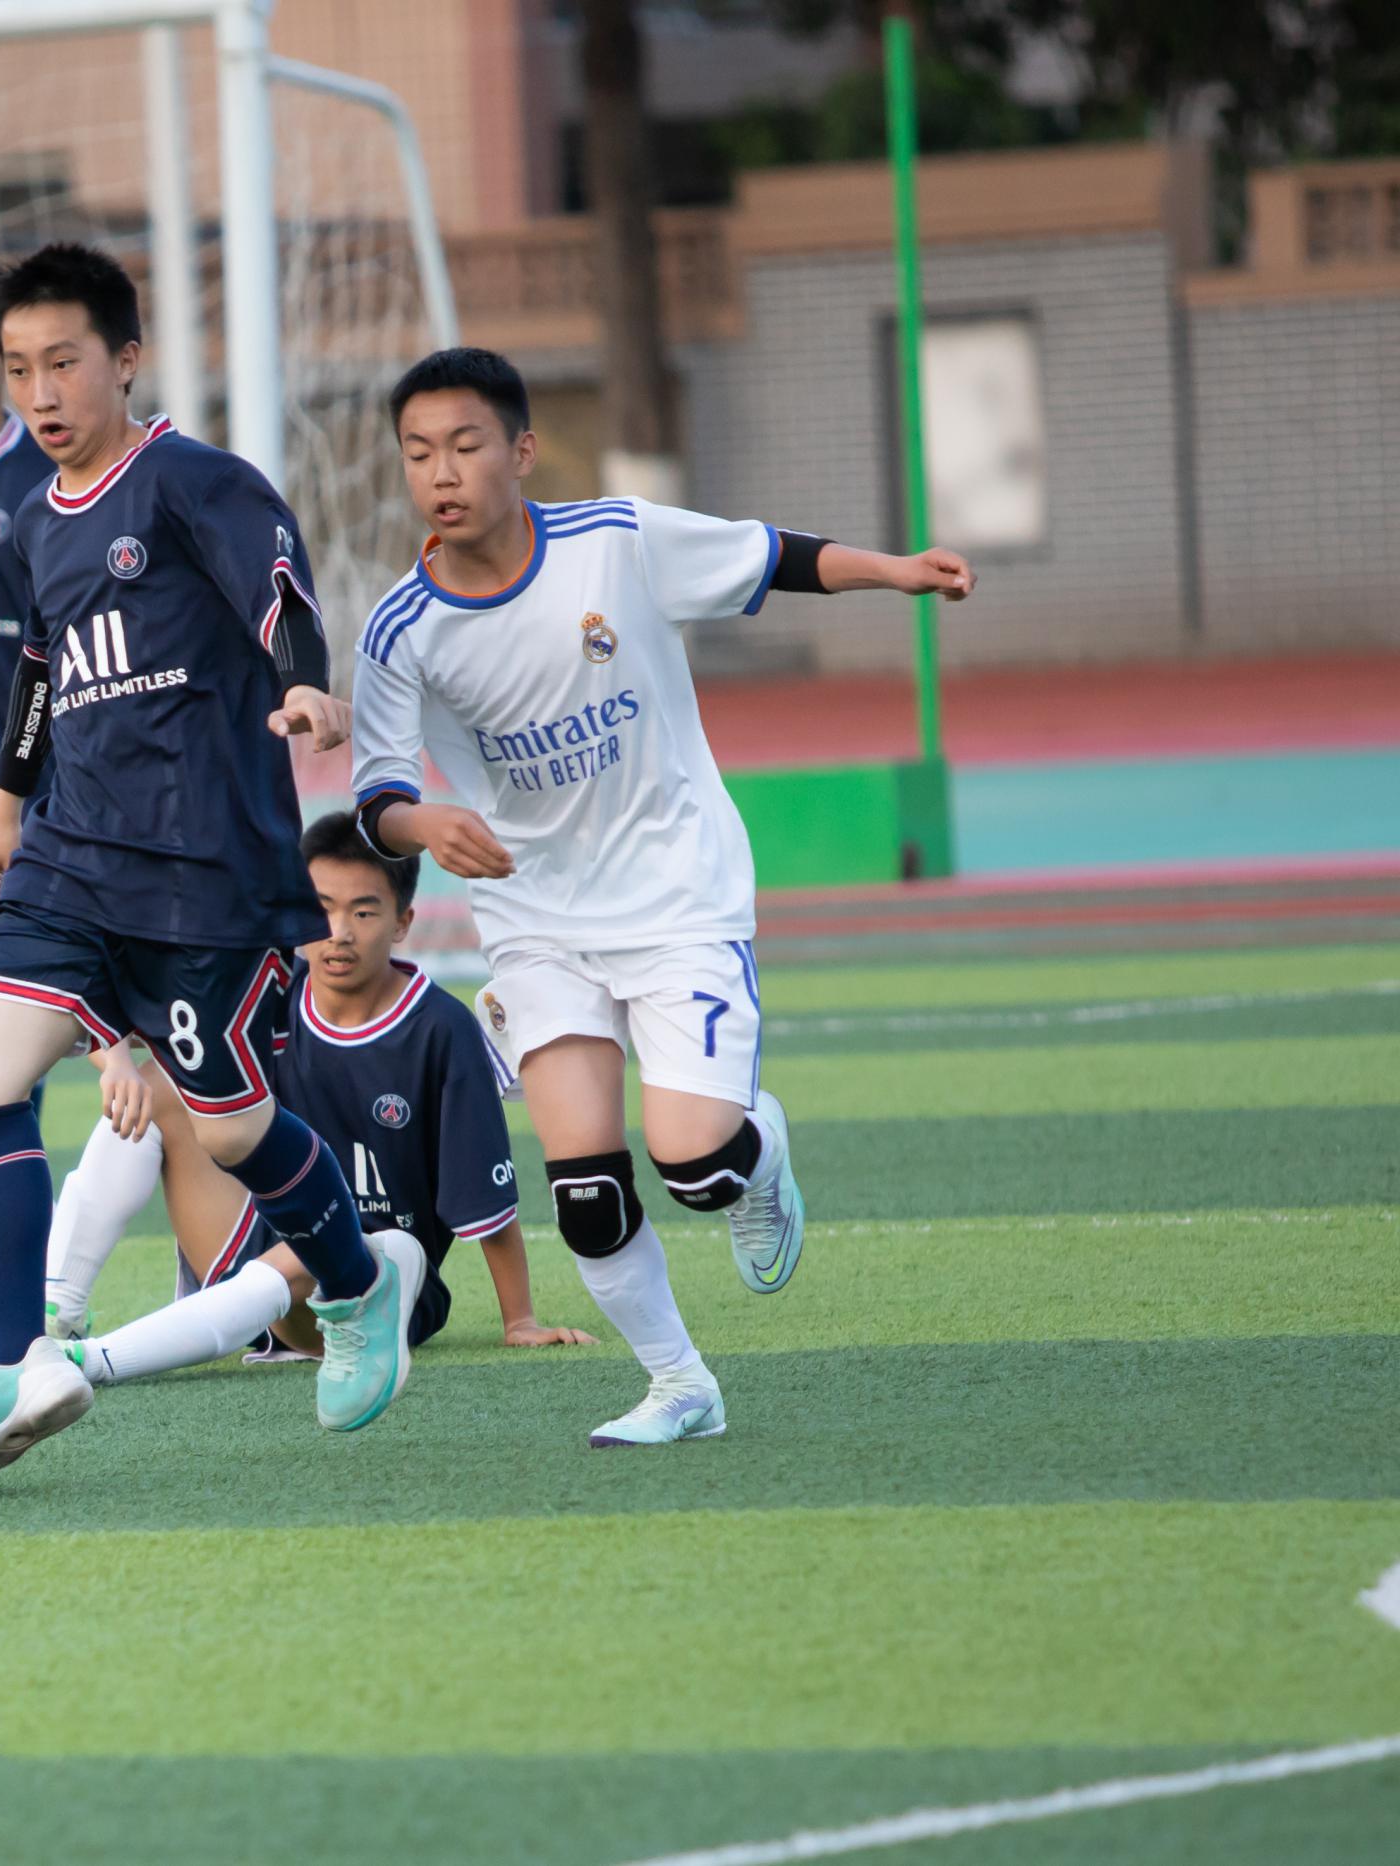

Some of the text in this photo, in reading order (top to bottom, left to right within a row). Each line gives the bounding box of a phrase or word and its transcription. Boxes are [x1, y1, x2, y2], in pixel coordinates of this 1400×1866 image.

[24, 681, 48, 734] ENDLESS
[70, 686, 99, 709] LIVE
[100, 668, 188, 700] LIMITLESS
[473, 689, 640, 763] Emirates
[508, 734, 621, 791] FLY BETTER
[168, 999, 205, 1072] 8
[692, 990, 730, 1058] 7
[492, 1159, 514, 1186] QN
